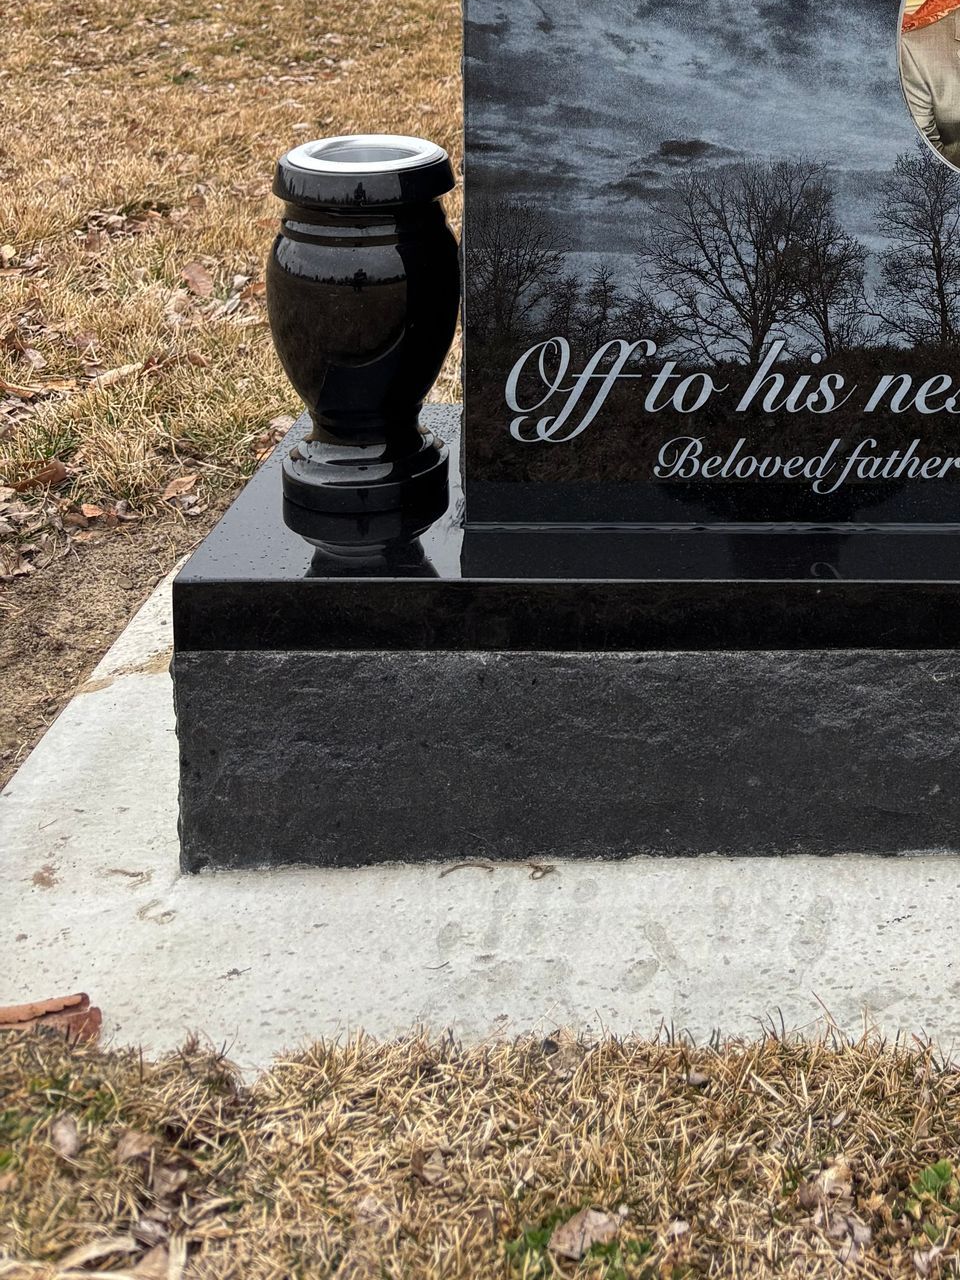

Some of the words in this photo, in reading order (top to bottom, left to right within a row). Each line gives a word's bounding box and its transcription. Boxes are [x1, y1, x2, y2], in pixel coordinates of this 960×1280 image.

[505, 336, 656, 443] Off
[643, 361, 729, 414] to
[736, 340, 858, 415] his
[653, 436, 838, 480] Beloved
